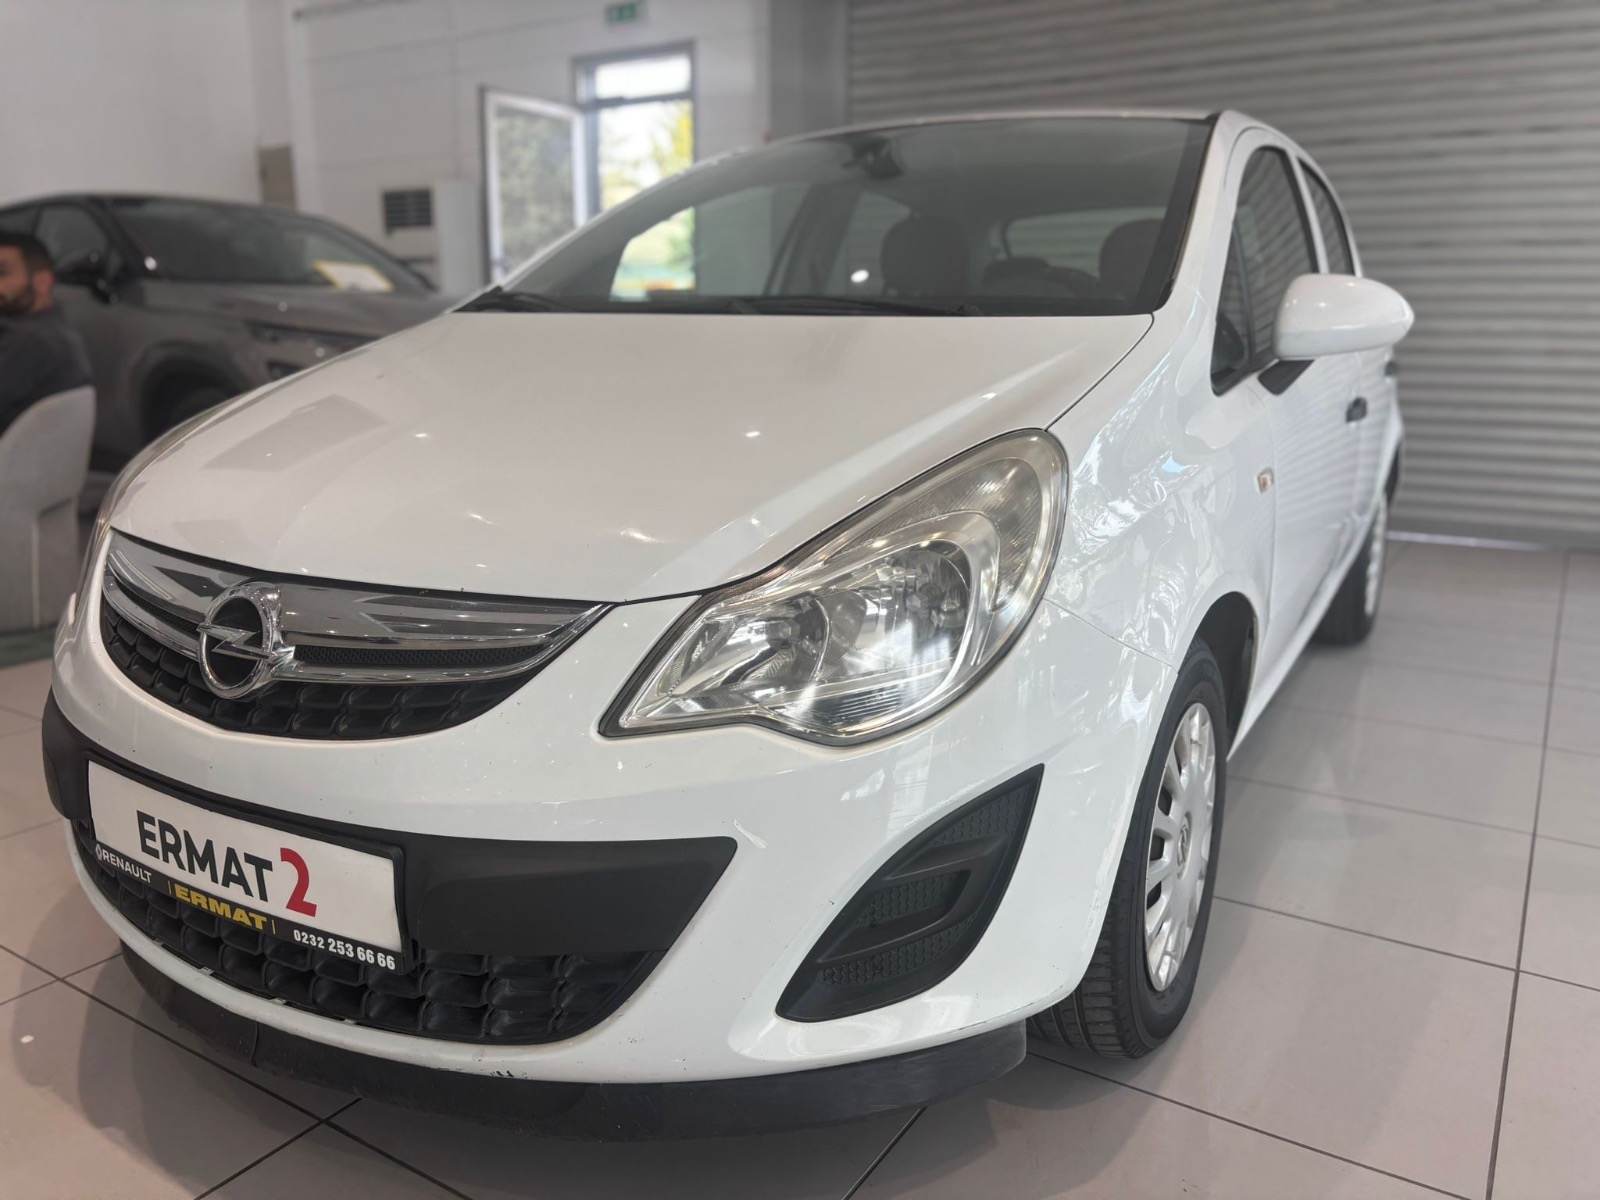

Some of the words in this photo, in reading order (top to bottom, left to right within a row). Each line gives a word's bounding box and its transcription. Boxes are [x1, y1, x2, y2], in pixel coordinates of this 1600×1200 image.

[102, 849, 152, 883] RENAULT
[136, 810, 273, 902] ERMAT
[280, 847, 318, 917] 2
[174, 883, 267, 930] ERMAT
[293, 929, 325, 949] 0232
[327, 938, 354, 958] 253
[356, 946, 375, 964] 66
[377, 952, 396, 970] 66
